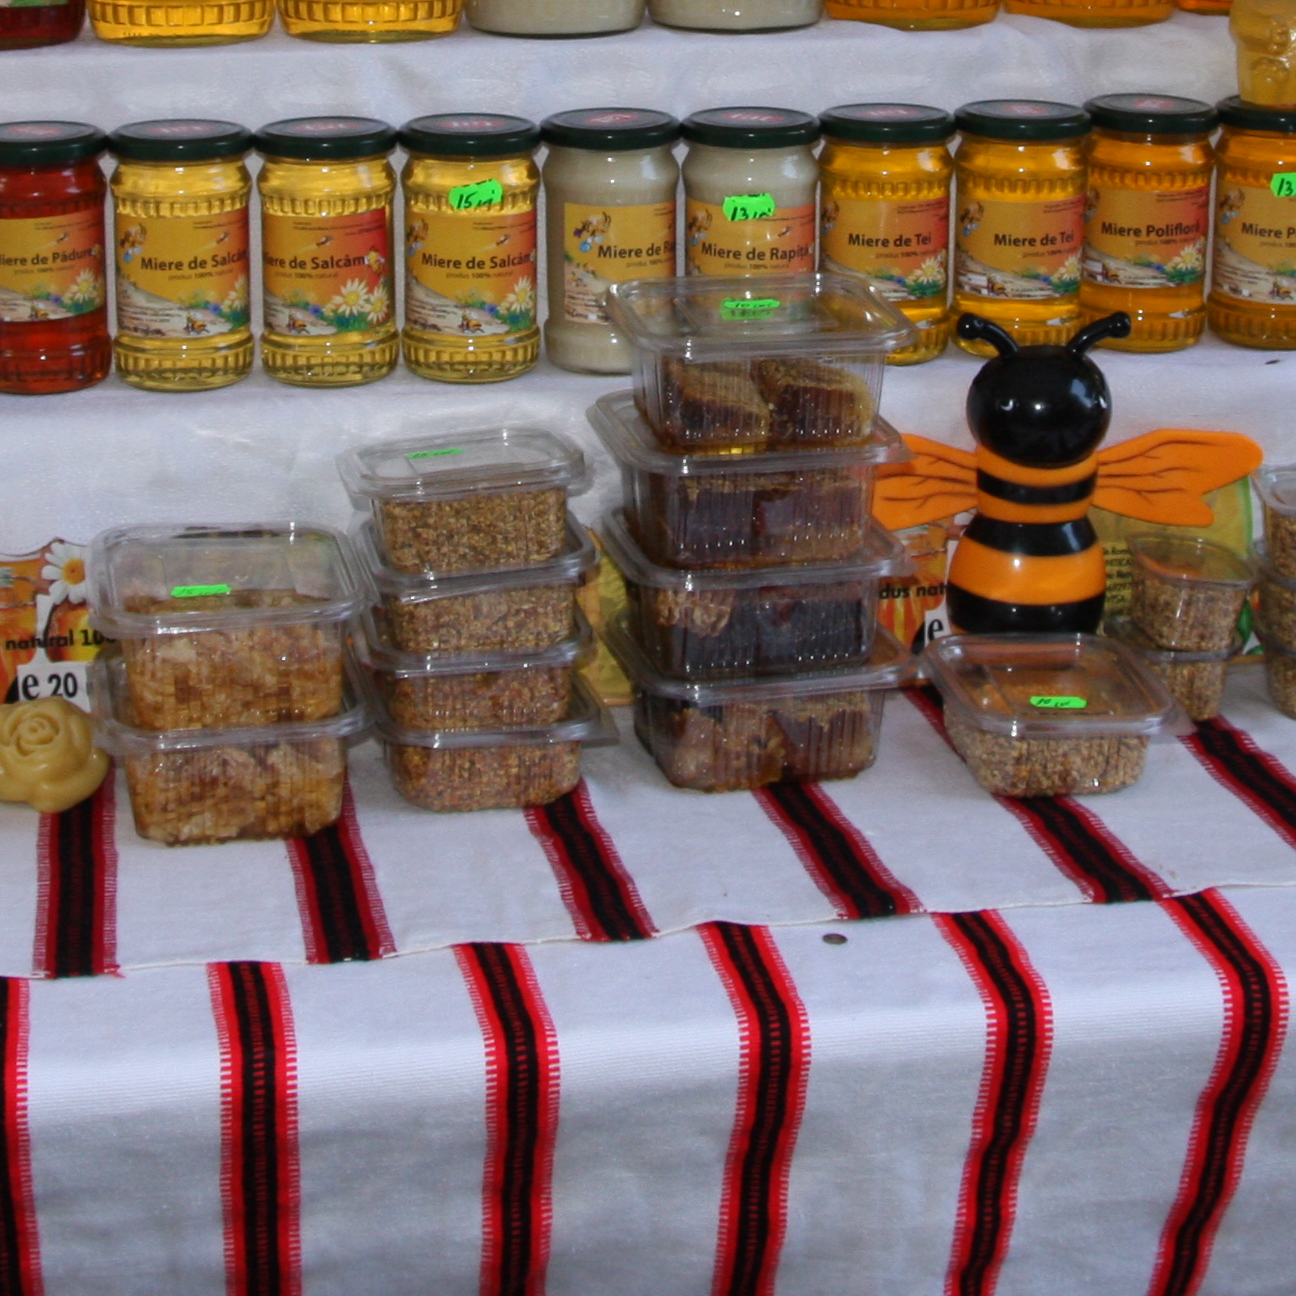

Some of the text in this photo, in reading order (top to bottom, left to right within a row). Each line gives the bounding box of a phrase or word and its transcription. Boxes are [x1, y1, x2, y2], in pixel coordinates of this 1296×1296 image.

[457, 191, 478, 209] 15
[1102, 221, 1142, 236] Miere
[1242, 222, 1282, 238] Miere
[848, 233, 932, 248] Miere de Tei
[994, 230, 1074, 247] Miere de Tei
[598, 245, 643, 258] Miere
[647, 243, 661, 257] de
[702, 242, 741, 260] Miere
[746, 247, 765, 261] de
[31, 254, 48, 266] de
[141, 257, 183, 271] Miere
[188, 256, 207, 270] de
[289, 256, 306, 269] de
[312, 255, 365, 270] Salcâm
[422, 253, 461, 269] Miere
[466, 256, 485, 269] de
[6, 629, 74, 651] natural
[48, 672, 78, 699] 20
